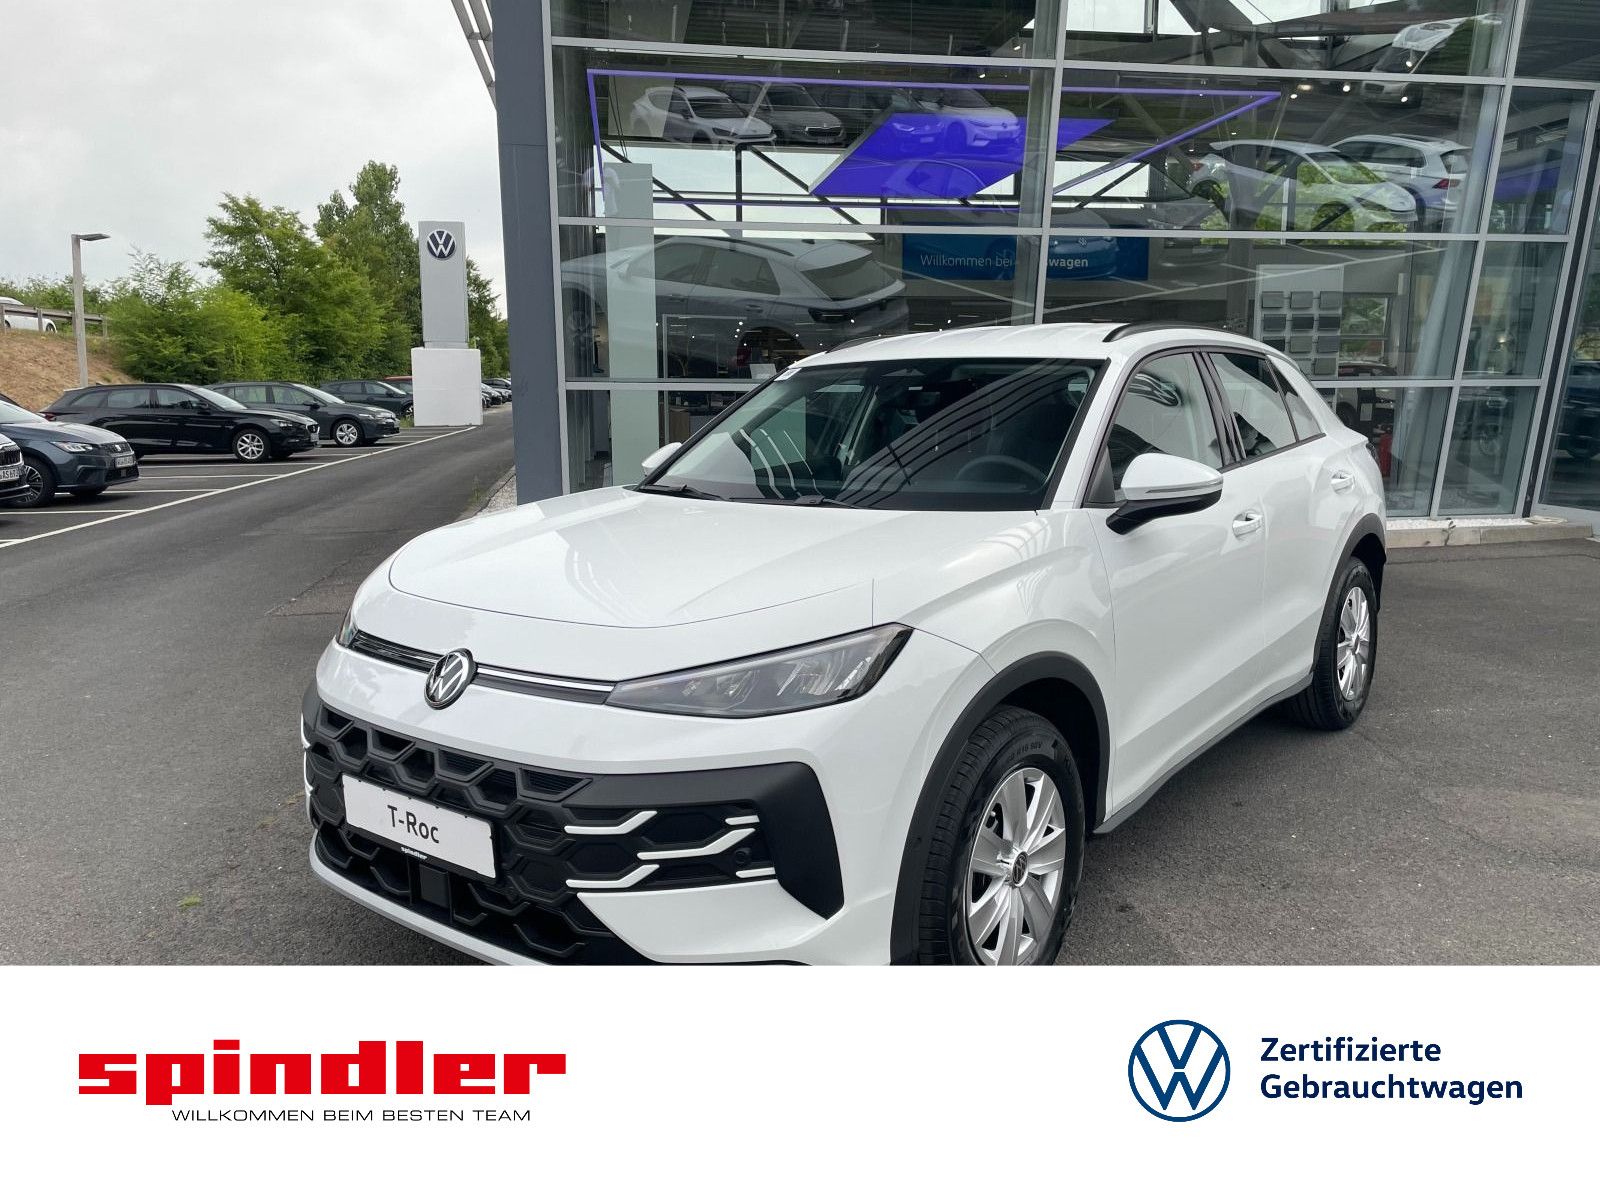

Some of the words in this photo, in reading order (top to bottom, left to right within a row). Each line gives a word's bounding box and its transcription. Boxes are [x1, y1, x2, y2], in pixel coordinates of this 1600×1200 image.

[920, 254, 992, 268] Willkommen
[995, 255, 1013, 268] bei
[1047, 258, 1089, 270] wagen
[387, 805, 440, 844] T-Roc
